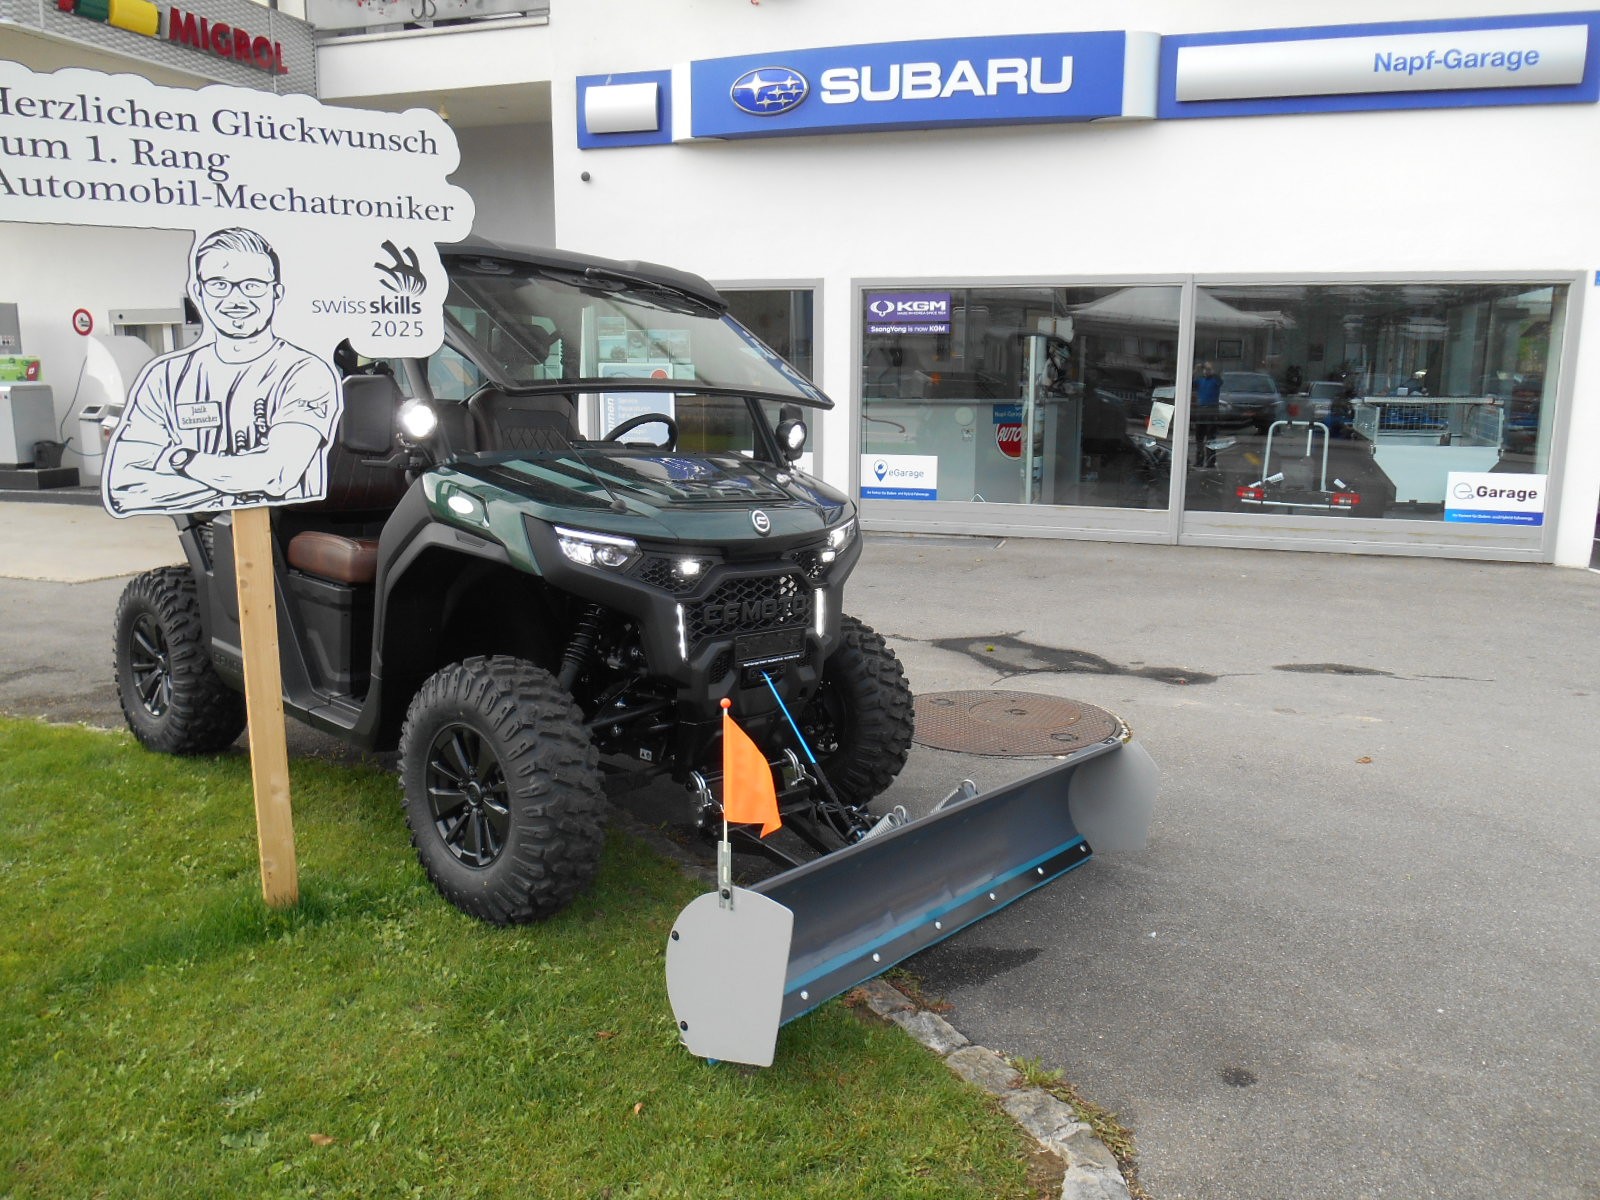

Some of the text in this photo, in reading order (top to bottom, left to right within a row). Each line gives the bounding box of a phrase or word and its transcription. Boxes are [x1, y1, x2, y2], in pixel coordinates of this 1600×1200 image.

[169, 6, 289, 75] MIGROL
[820, 56, 1074, 105] SUBARU
[1373, 48, 1540, 76] Napf-Garage
[211, 108, 440, 156] Glückwunsch
[86, 135, 118, 165] 1.
[129, 137, 231, 183] Rang
[896, 301, 947, 312] KGM
[371, 320, 424, 337] 2025
[888, 468, 925, 478] eGarage
